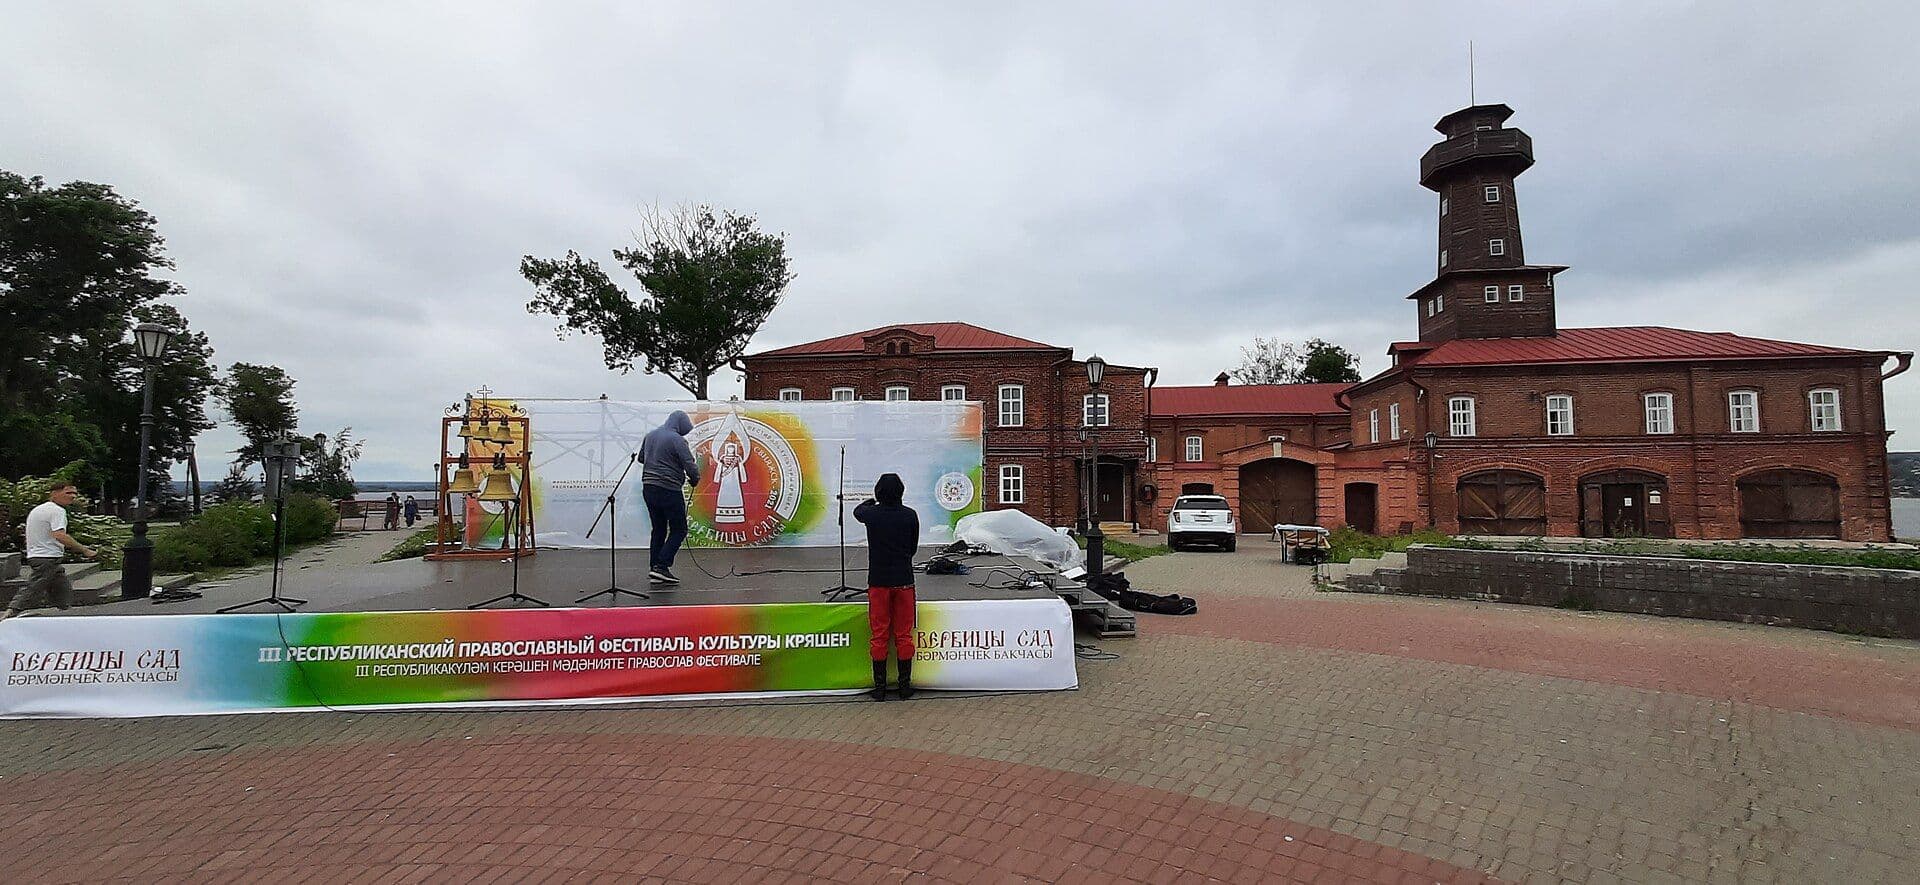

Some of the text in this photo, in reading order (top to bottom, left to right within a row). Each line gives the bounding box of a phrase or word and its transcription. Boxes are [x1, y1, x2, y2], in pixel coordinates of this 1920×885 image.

[764, 489, 778, 509] 2021
[753, 514, 780, 537] САД
[286, 638, 455, 662] РЕСПУБЛИКАНСКИЙ
[458, 635, 595, 658] ПРАВОСЛАВНЫЙ
[599, 636, 695, 654] ФЕСТИВАЛЬ
[698, 634, 781, 651] КУЛЬТУРЫ
[785, 632, 850, 649] КРЯШЕН
[916, 629, 1054, 650] ВЕРБИЦЫ САД
[11, 649, 181, 673] ВЕРБИЦЫ САД
[373, 661, 489, 676] РЕСПУБЛИКАКҮЛӘМ
[493, 659, 549, 673] КЕРӘШЕН
[552, 657, 625, 673] МӘДӘНИЯТЕ
[628, 655, 693, 669] ПРАВОСЛАВ
[696, 653, 761, 667] ФЕСТИВАЛЕ
[916, 648, 1053, 661] БӘРМӘНЧЕК БАКЧАСЫ
[7, 671, 178, 686] БӘРМӘНЧЕК БАКЧАСЫ
